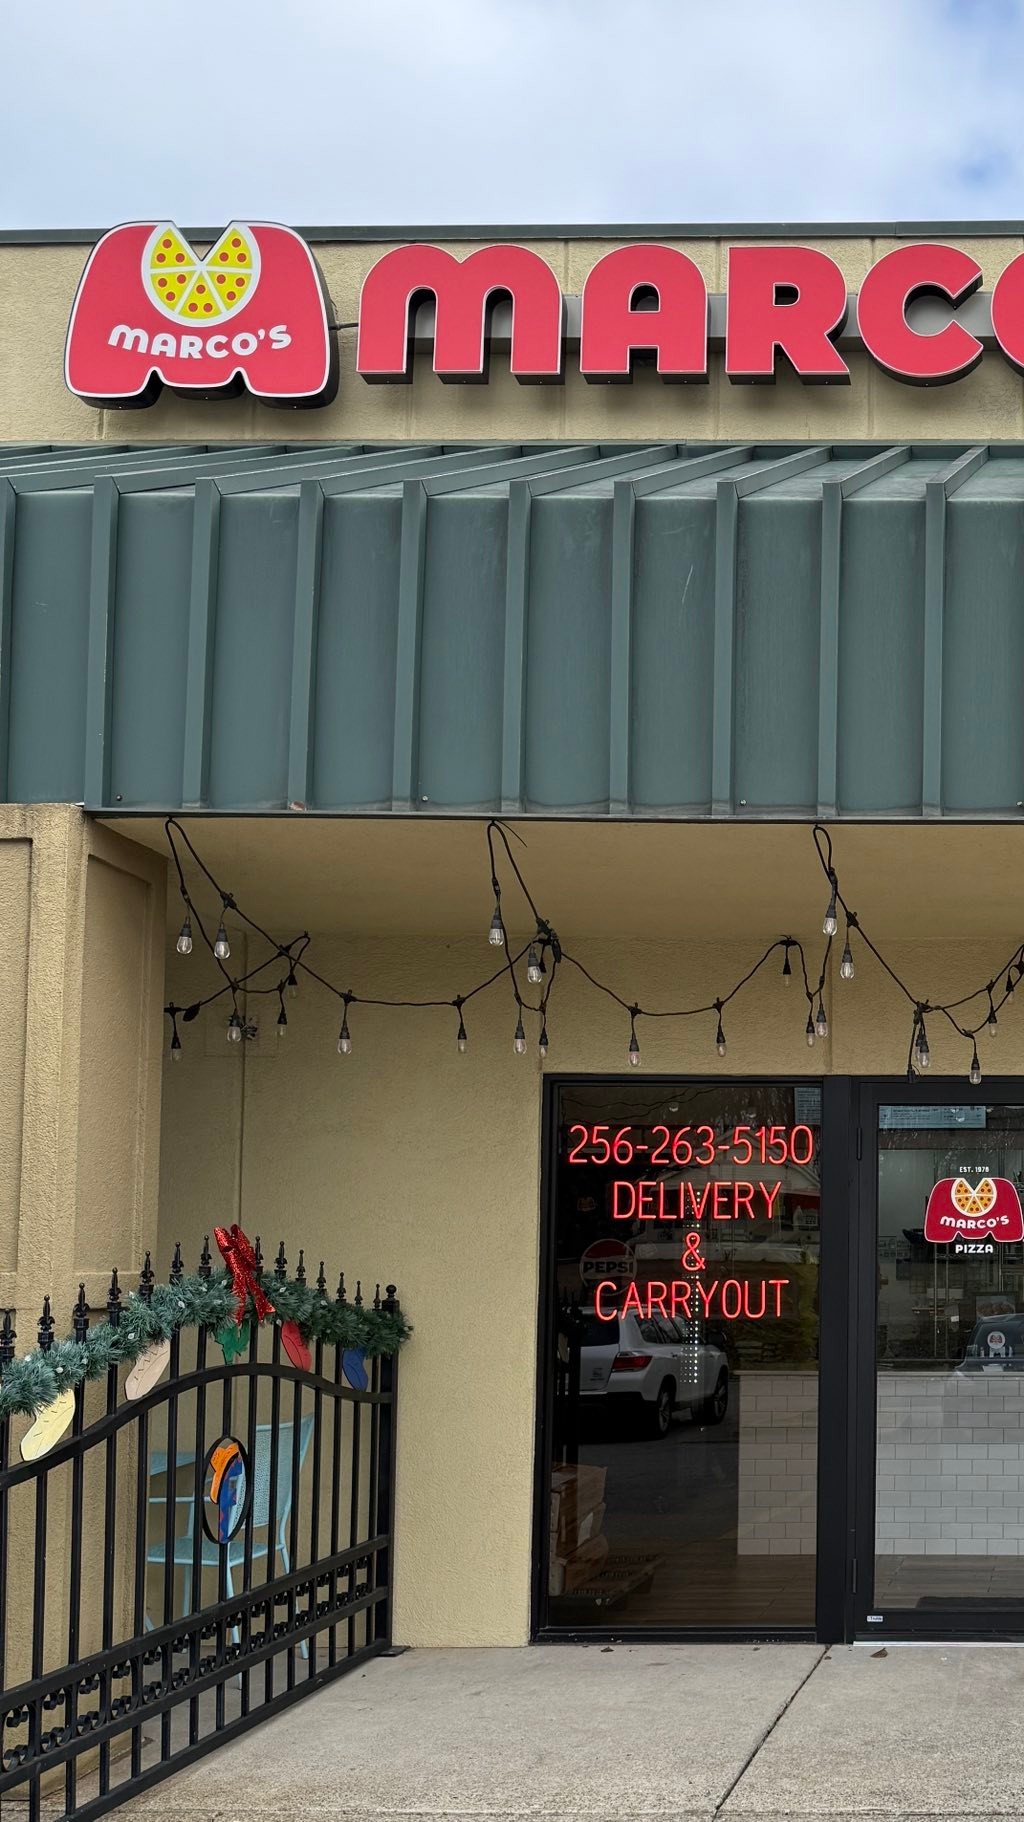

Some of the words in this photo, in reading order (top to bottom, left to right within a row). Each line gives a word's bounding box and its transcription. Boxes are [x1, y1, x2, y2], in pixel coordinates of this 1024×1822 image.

[107, 324, 292, 359] MARCO'S
[568, 1124, 814, 1166] 256-263-5150
[612, 1181, 782, 1220] DELIVERY
[940, 1215, 1010, 1229] MARCO'S
[583, 1261, 634, 1273] PEPSI
[682, 1232, 706, 1271] &
[955, 1244, 994, 1253] PIZZA
[595, 1279, 790, 1320] CARRYOUT
